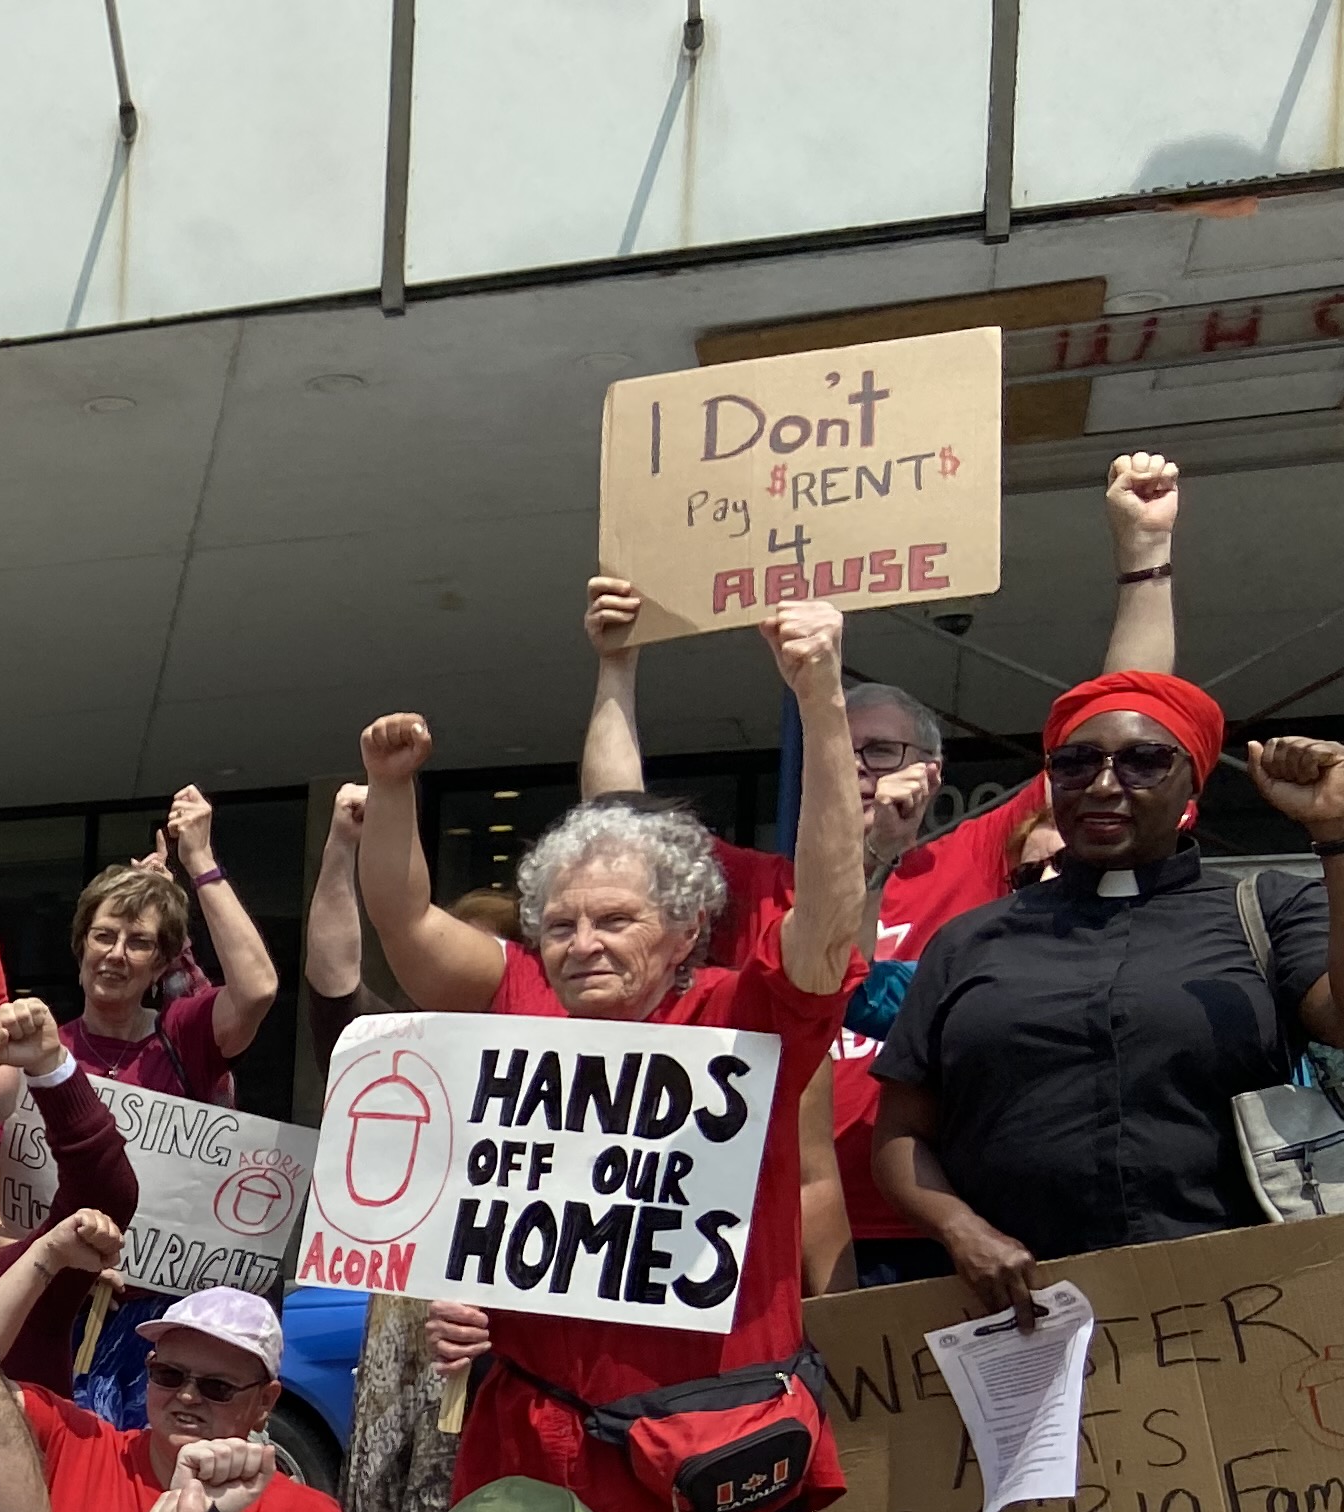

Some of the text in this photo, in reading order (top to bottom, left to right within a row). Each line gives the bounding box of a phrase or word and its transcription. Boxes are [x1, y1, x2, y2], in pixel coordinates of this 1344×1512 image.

[700, 370, 891, 462] Don't
[687, 490, 751, 537] Pay
[768, 526, 811, 564] 4
[712, 543, 950, 615] ABUSE
[468, 1049, 750, 1142] HANDS
[9, 1123, 47, 1169] IS
[239, 1149, 305, 1180] ACORN
[467, 1139, 693, 1205] OFF OUR
[150, 1233, 279, 1294] RIGHT
[299, 1232, 415, 1291] ACORN
[445, 1197, 741, 1310] HOMES
